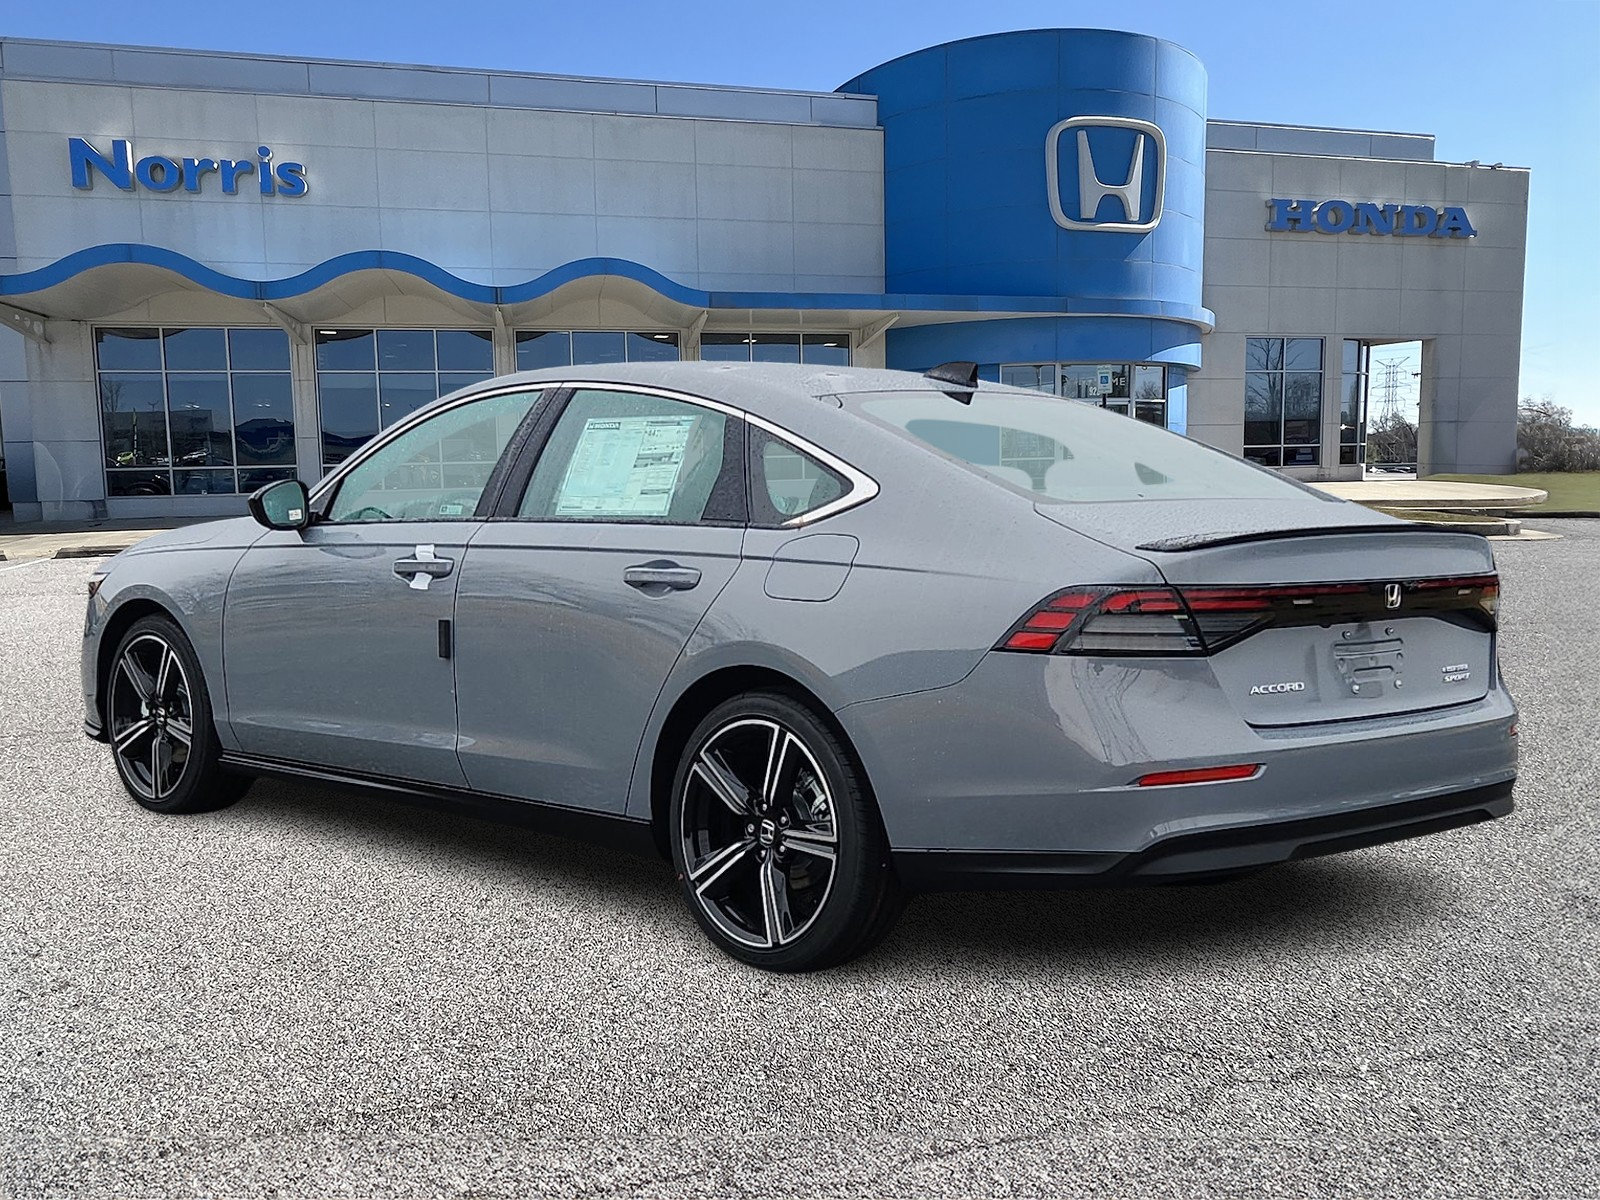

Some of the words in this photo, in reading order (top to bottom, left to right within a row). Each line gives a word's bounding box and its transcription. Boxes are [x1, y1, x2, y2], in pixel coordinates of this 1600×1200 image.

[68, 136, 309, 198] Norris
[1265, 198, 1478, 239] HONDA
[1249, 681, 1305, 696] ACCORD
[1443, 672, 1470, 682] SPORT
